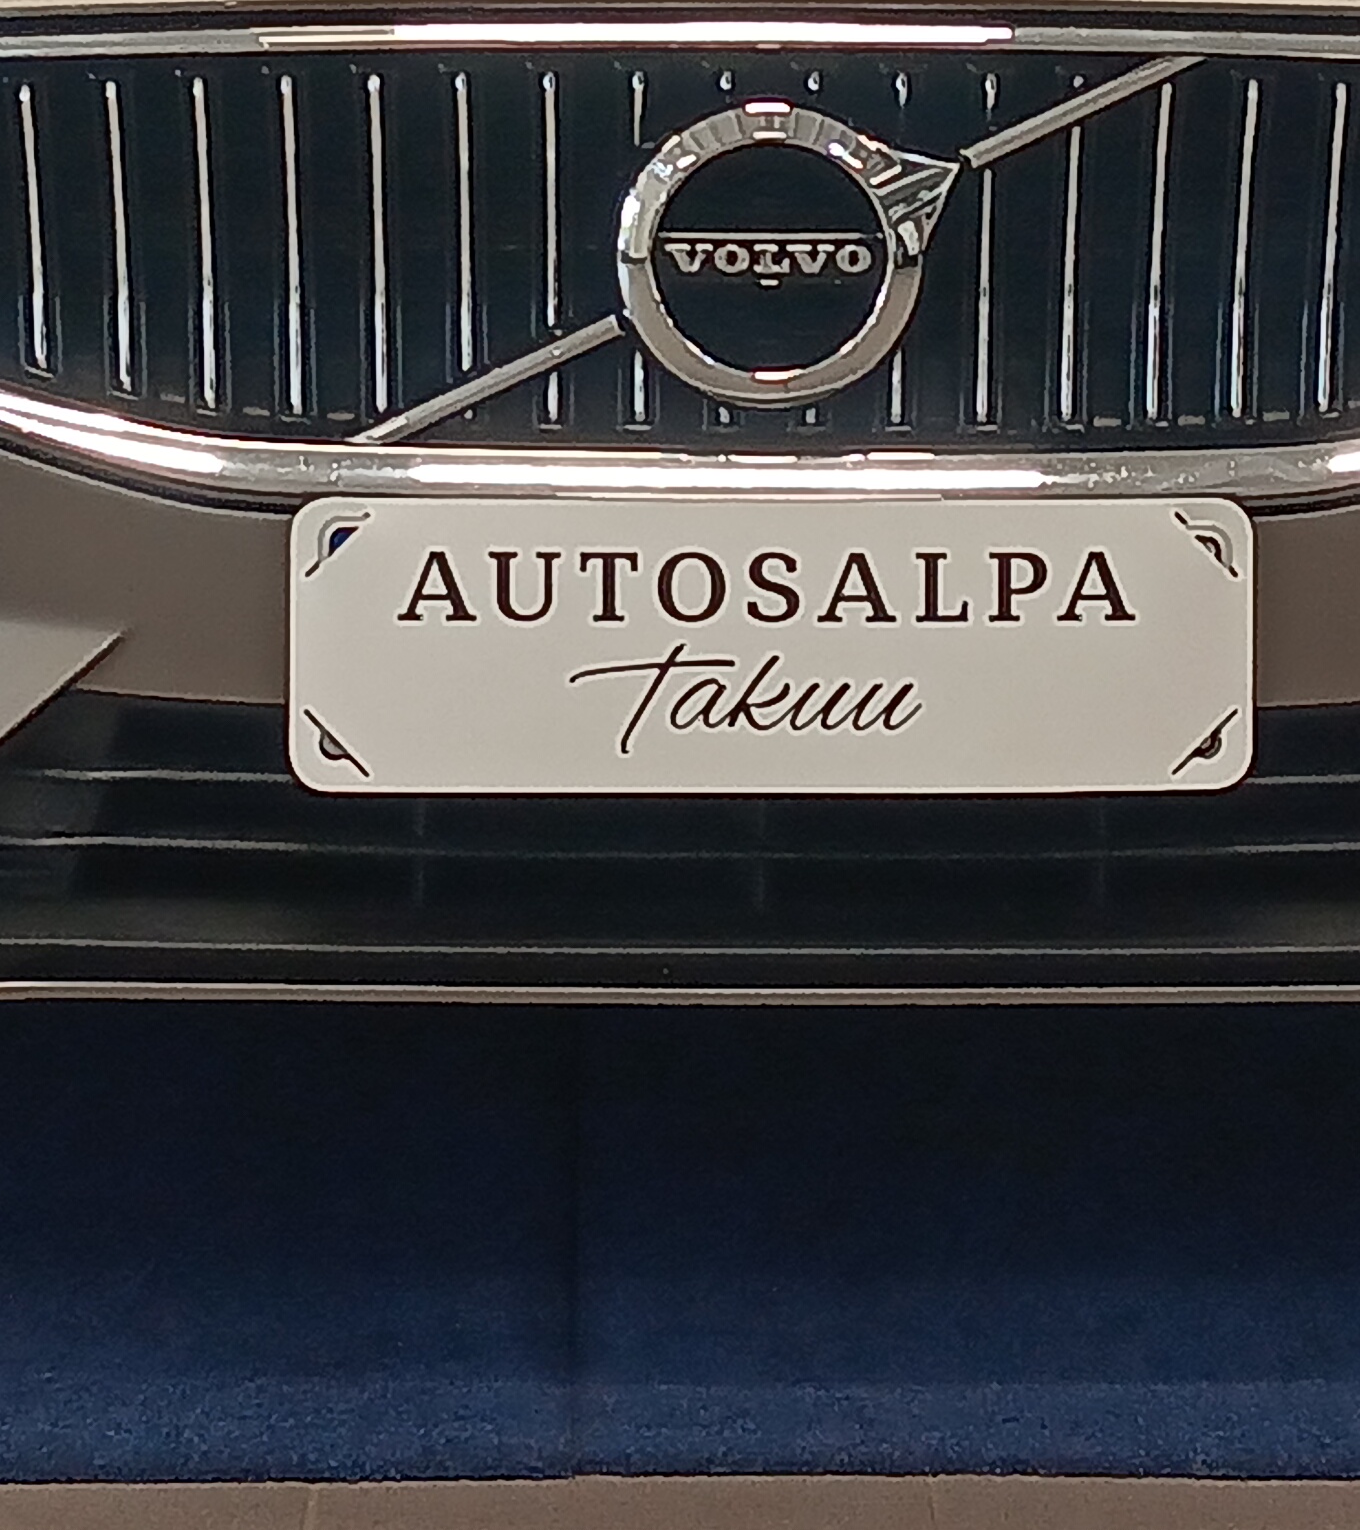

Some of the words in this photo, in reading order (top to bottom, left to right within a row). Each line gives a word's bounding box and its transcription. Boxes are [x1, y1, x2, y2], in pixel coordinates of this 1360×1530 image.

[663, 243, 873, 274] VOLVO
[397, 550, 1137, 624] AUTOSALPA
[569, 642, 923, 756] Takuu
